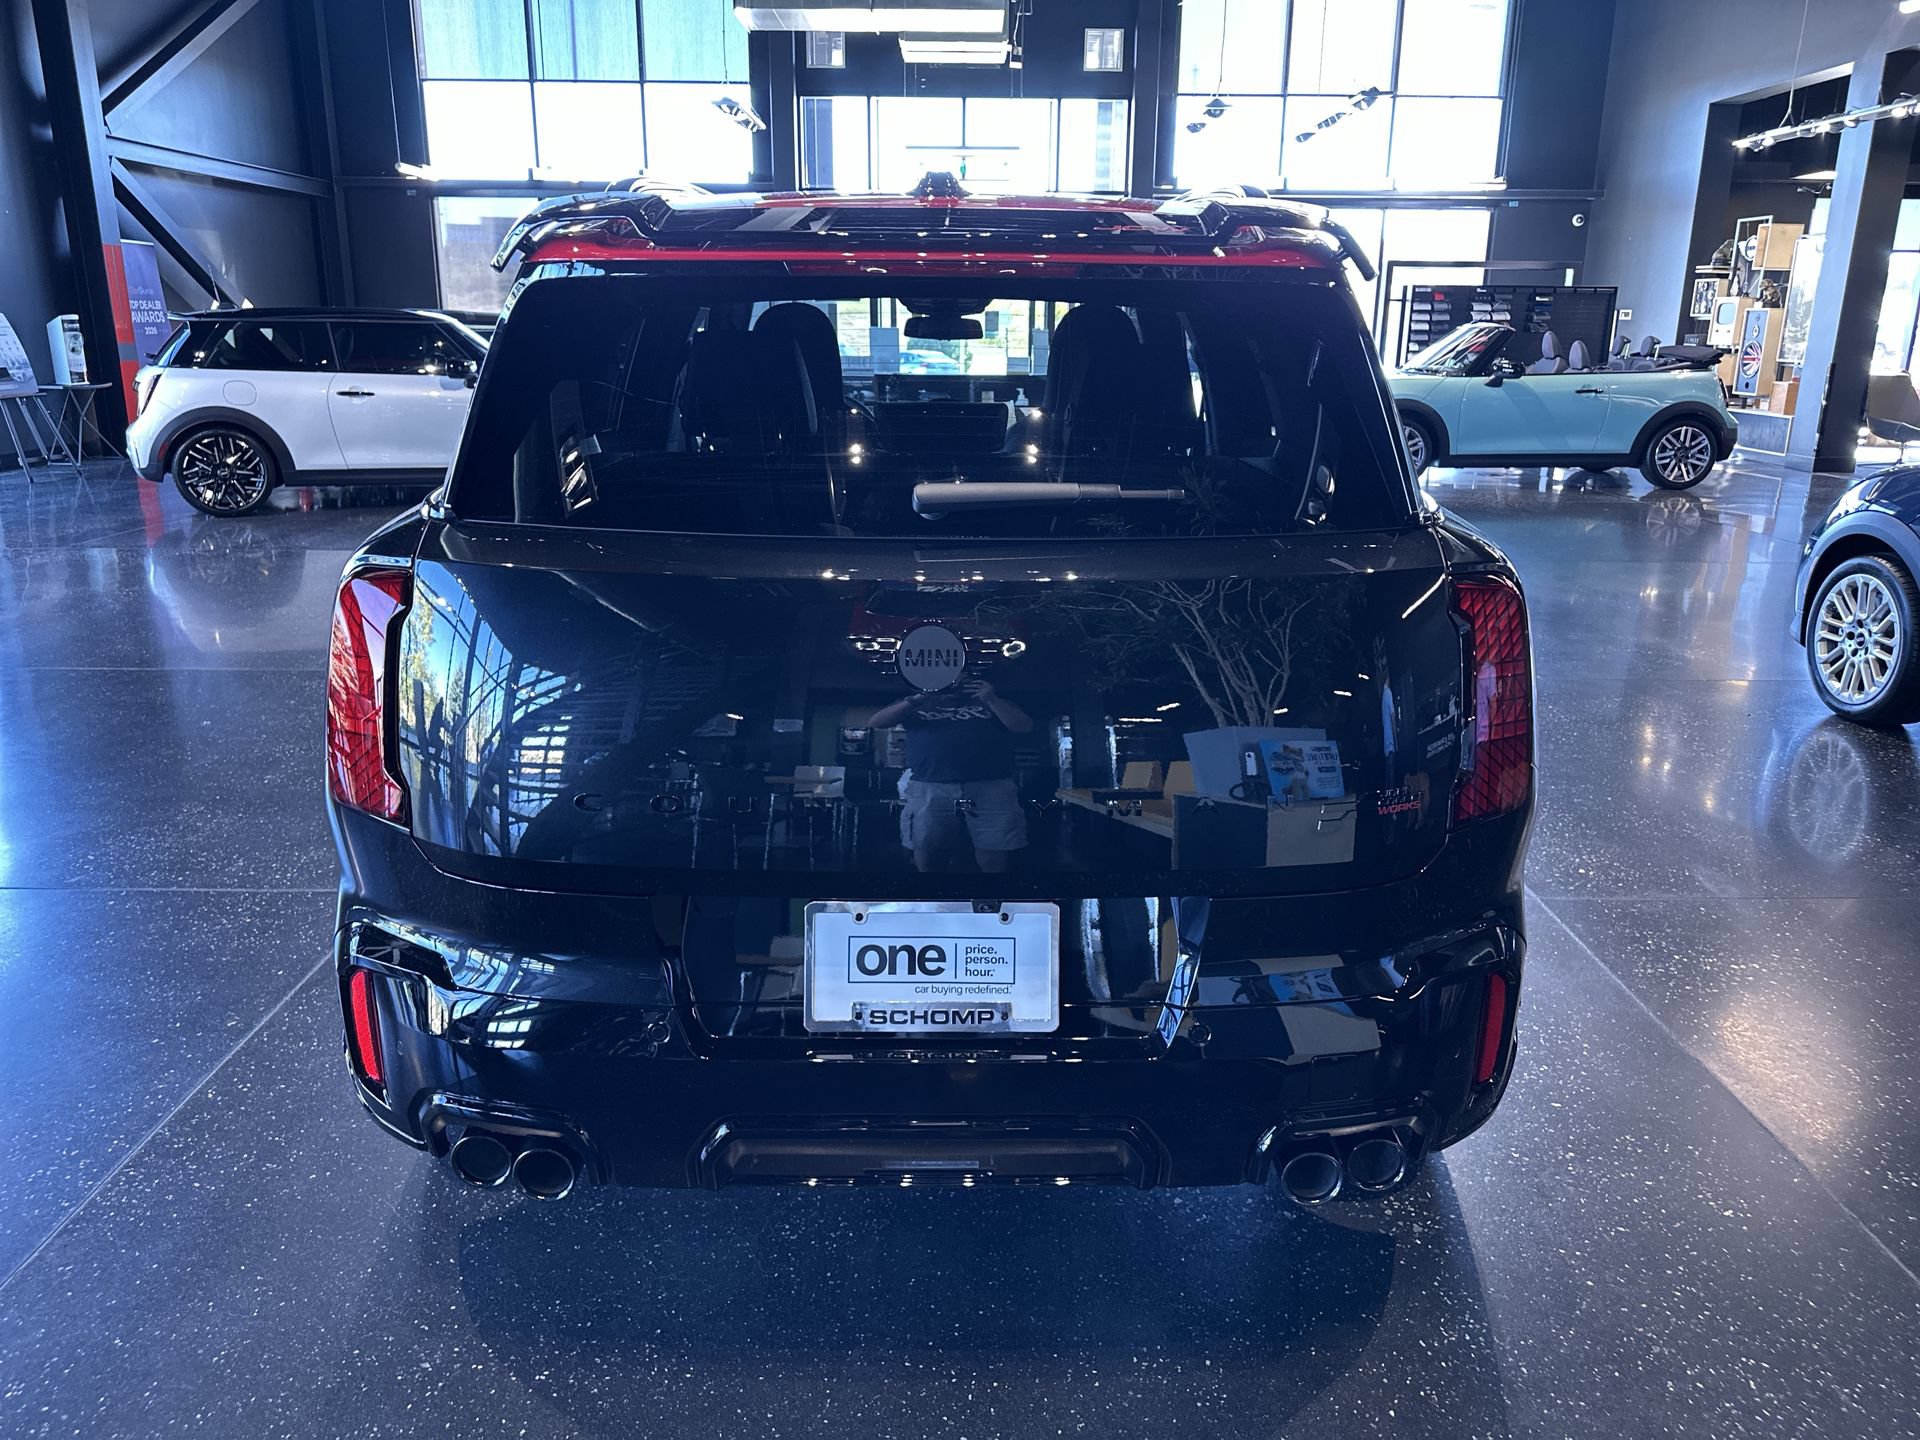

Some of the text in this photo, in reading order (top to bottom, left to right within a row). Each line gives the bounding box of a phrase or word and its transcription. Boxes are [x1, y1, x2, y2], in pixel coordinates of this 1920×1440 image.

[139, 300, 162, 310] DEALER
[132, 311, 165, 323] AWARDS
[905, 649, 958, 667] MINI
[1378, 800, 1421, 815] WORKS
[965, 944, 997, 955] price.
[856, 944, 947, 976] one
[965, 955, 1008, 965] person.
[965, 967, 994, 977] hour.
[914, 985, 1010, 995] car buying redefined.
[869, 1009, 994, 1025] SCHOMP
